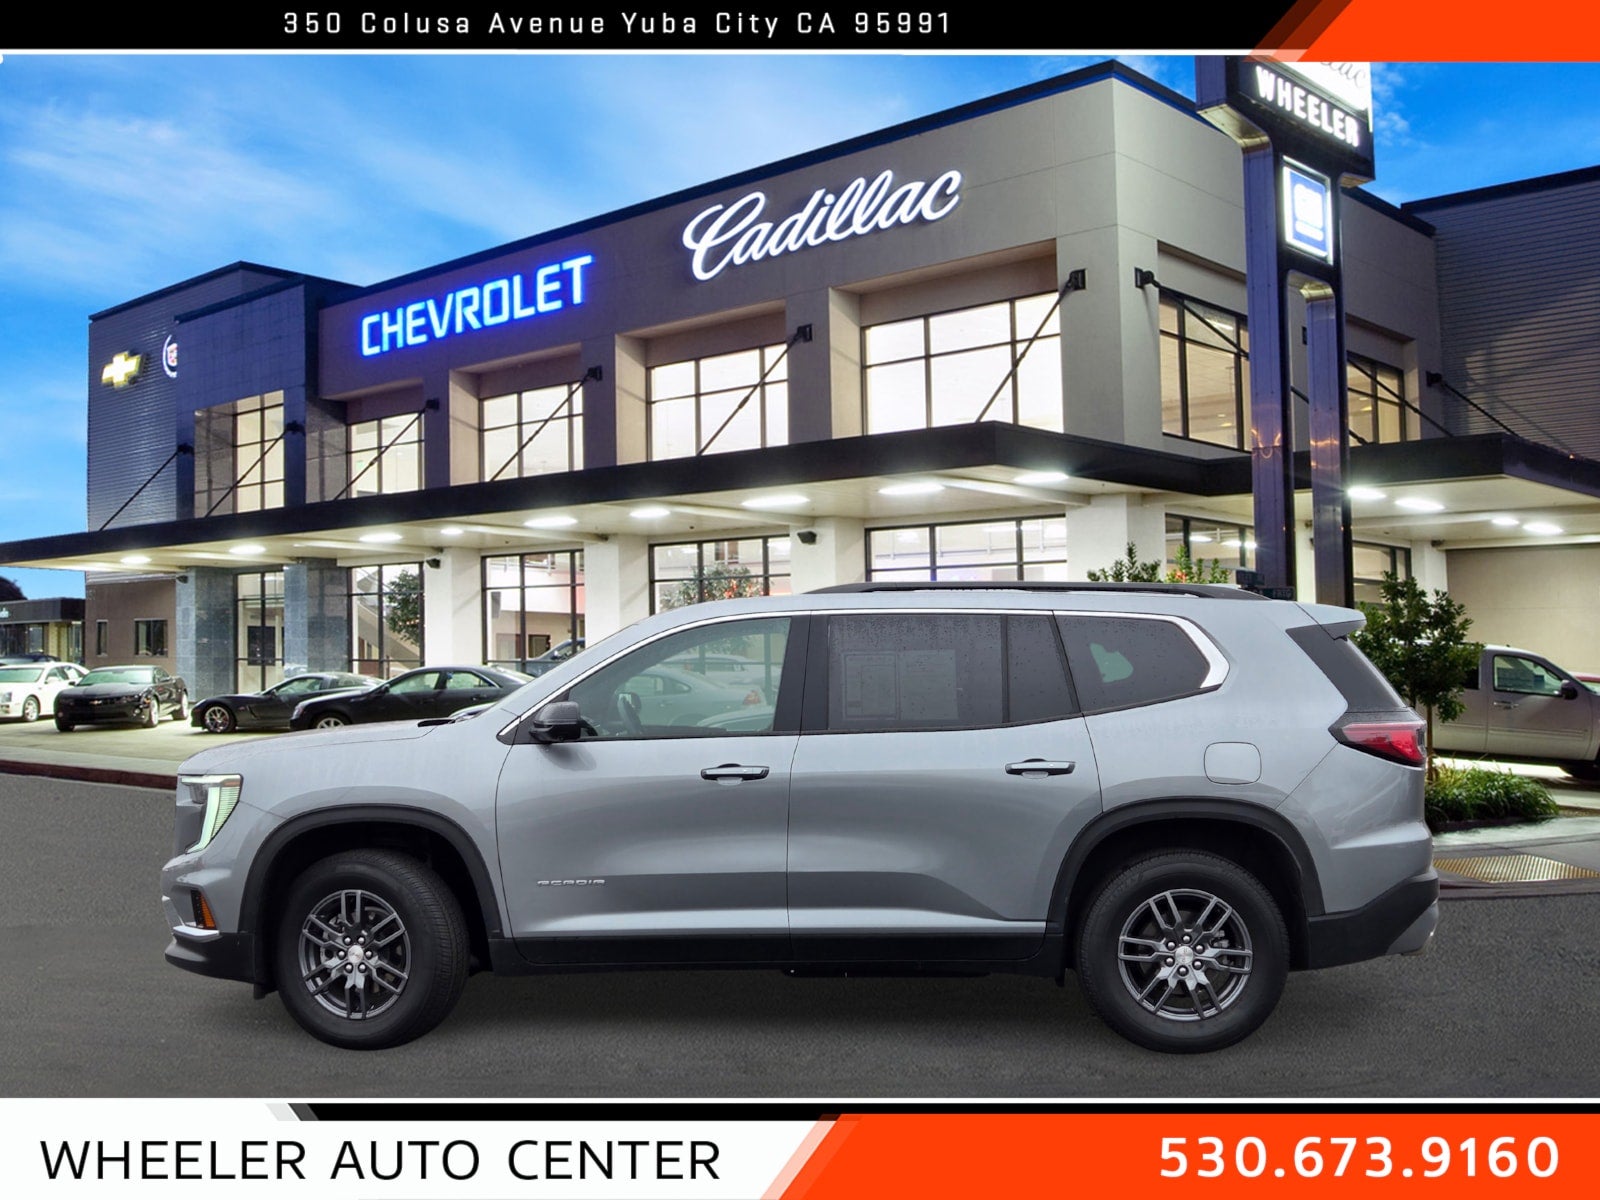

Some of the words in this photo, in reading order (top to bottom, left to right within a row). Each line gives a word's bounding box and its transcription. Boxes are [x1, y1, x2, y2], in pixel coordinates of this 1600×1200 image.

[1255, 65, 1360, 147] WHEELER
[681, 169, 962, 281] Cadillac
[360, 255, 594, 357] CHEVROLET
